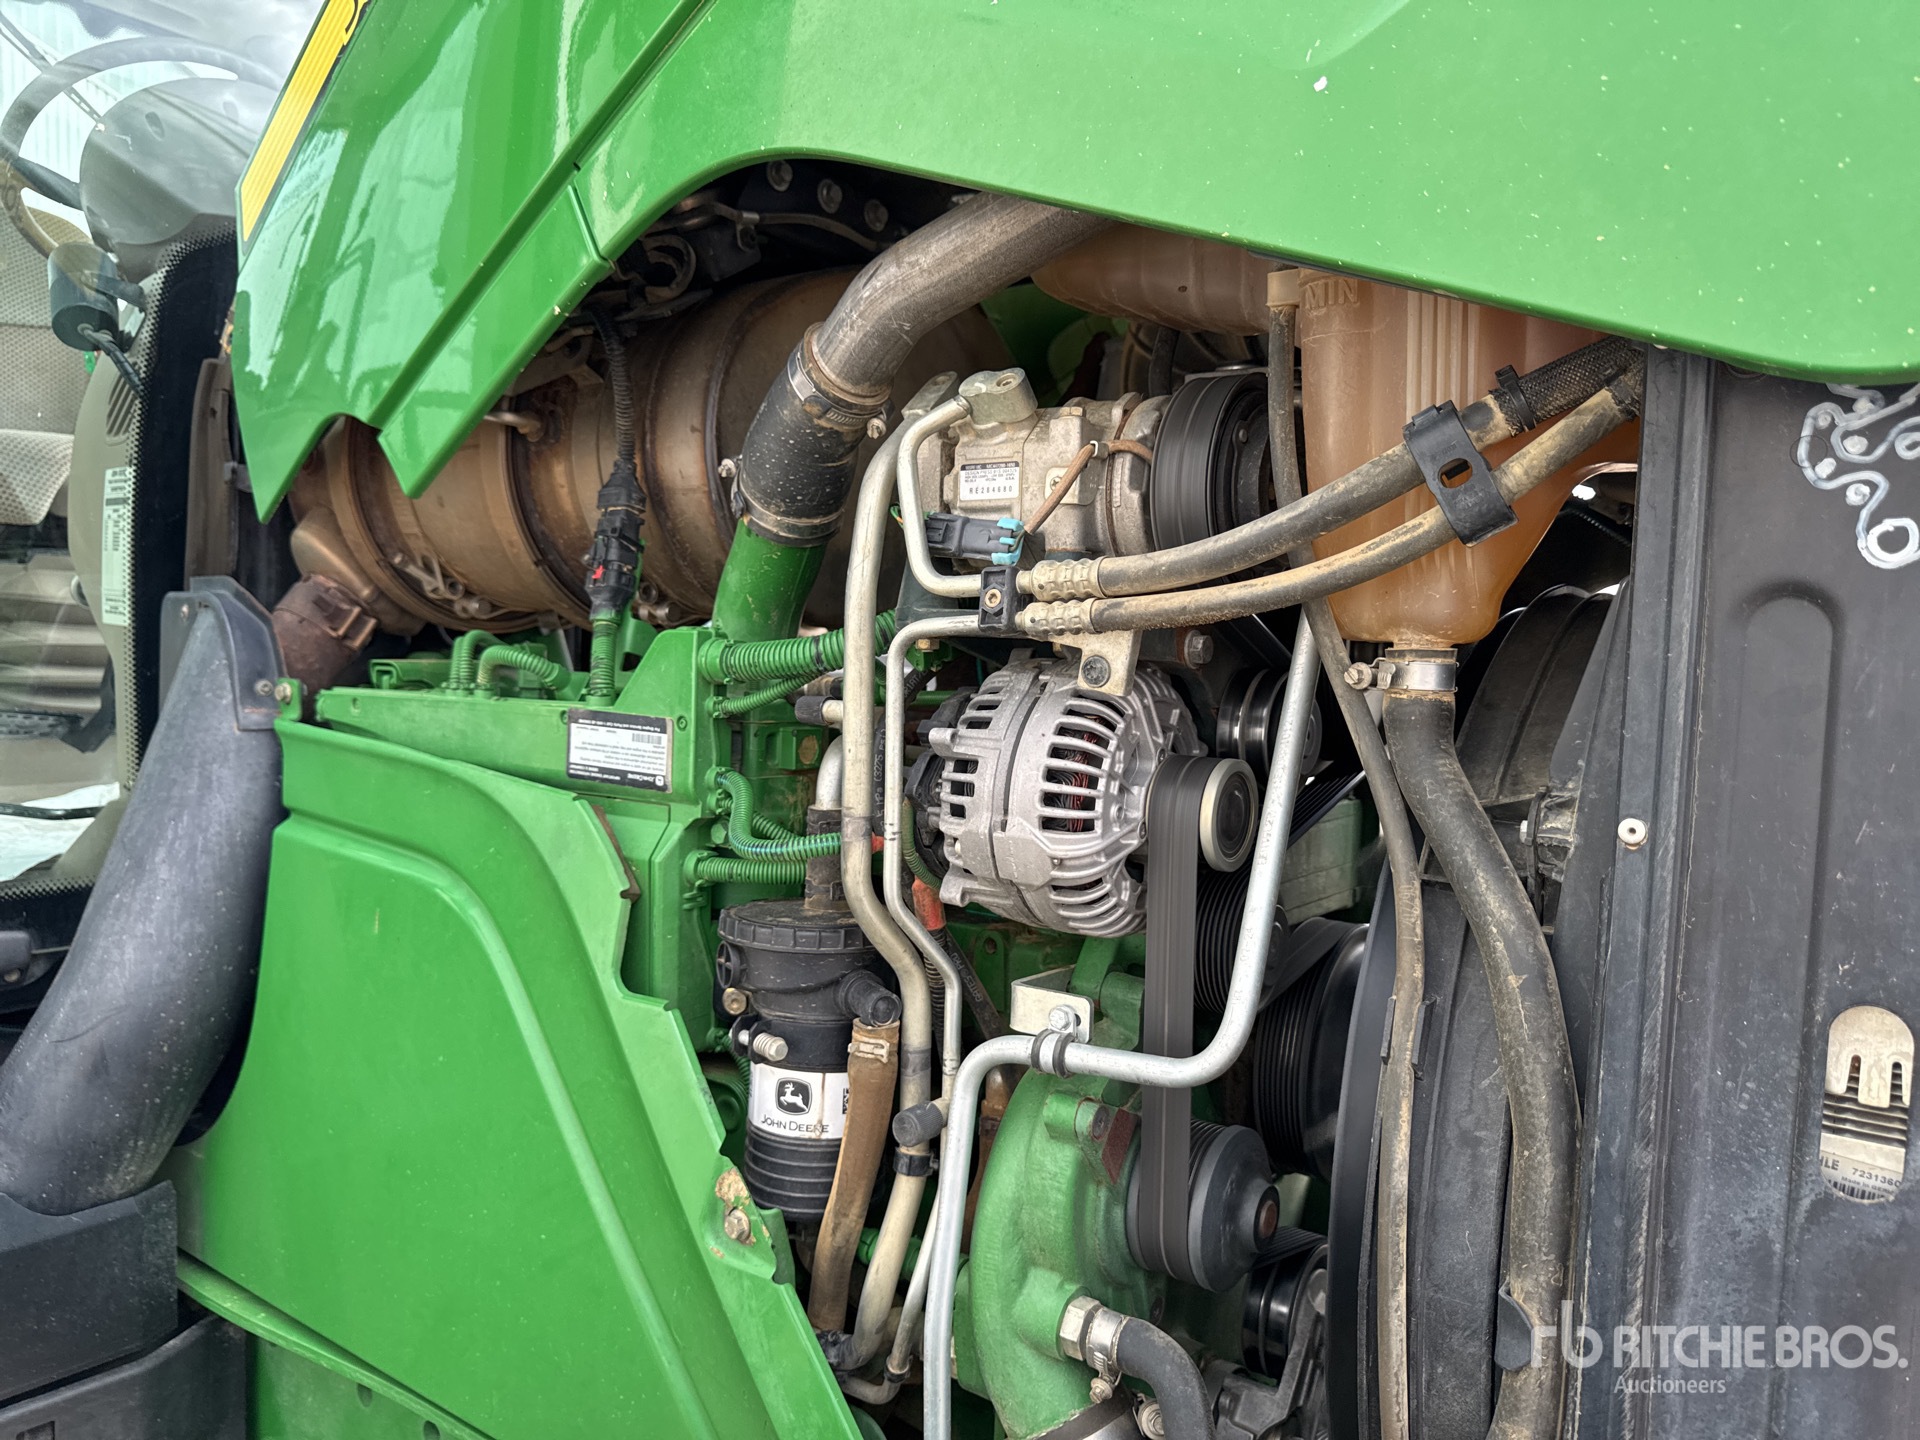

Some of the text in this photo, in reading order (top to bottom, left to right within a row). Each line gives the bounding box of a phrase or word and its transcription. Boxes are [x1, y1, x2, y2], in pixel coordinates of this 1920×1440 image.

[1304, 277, 1360, 310] MIN
[761, 1114, 829, 1136] JOHN DEERE
